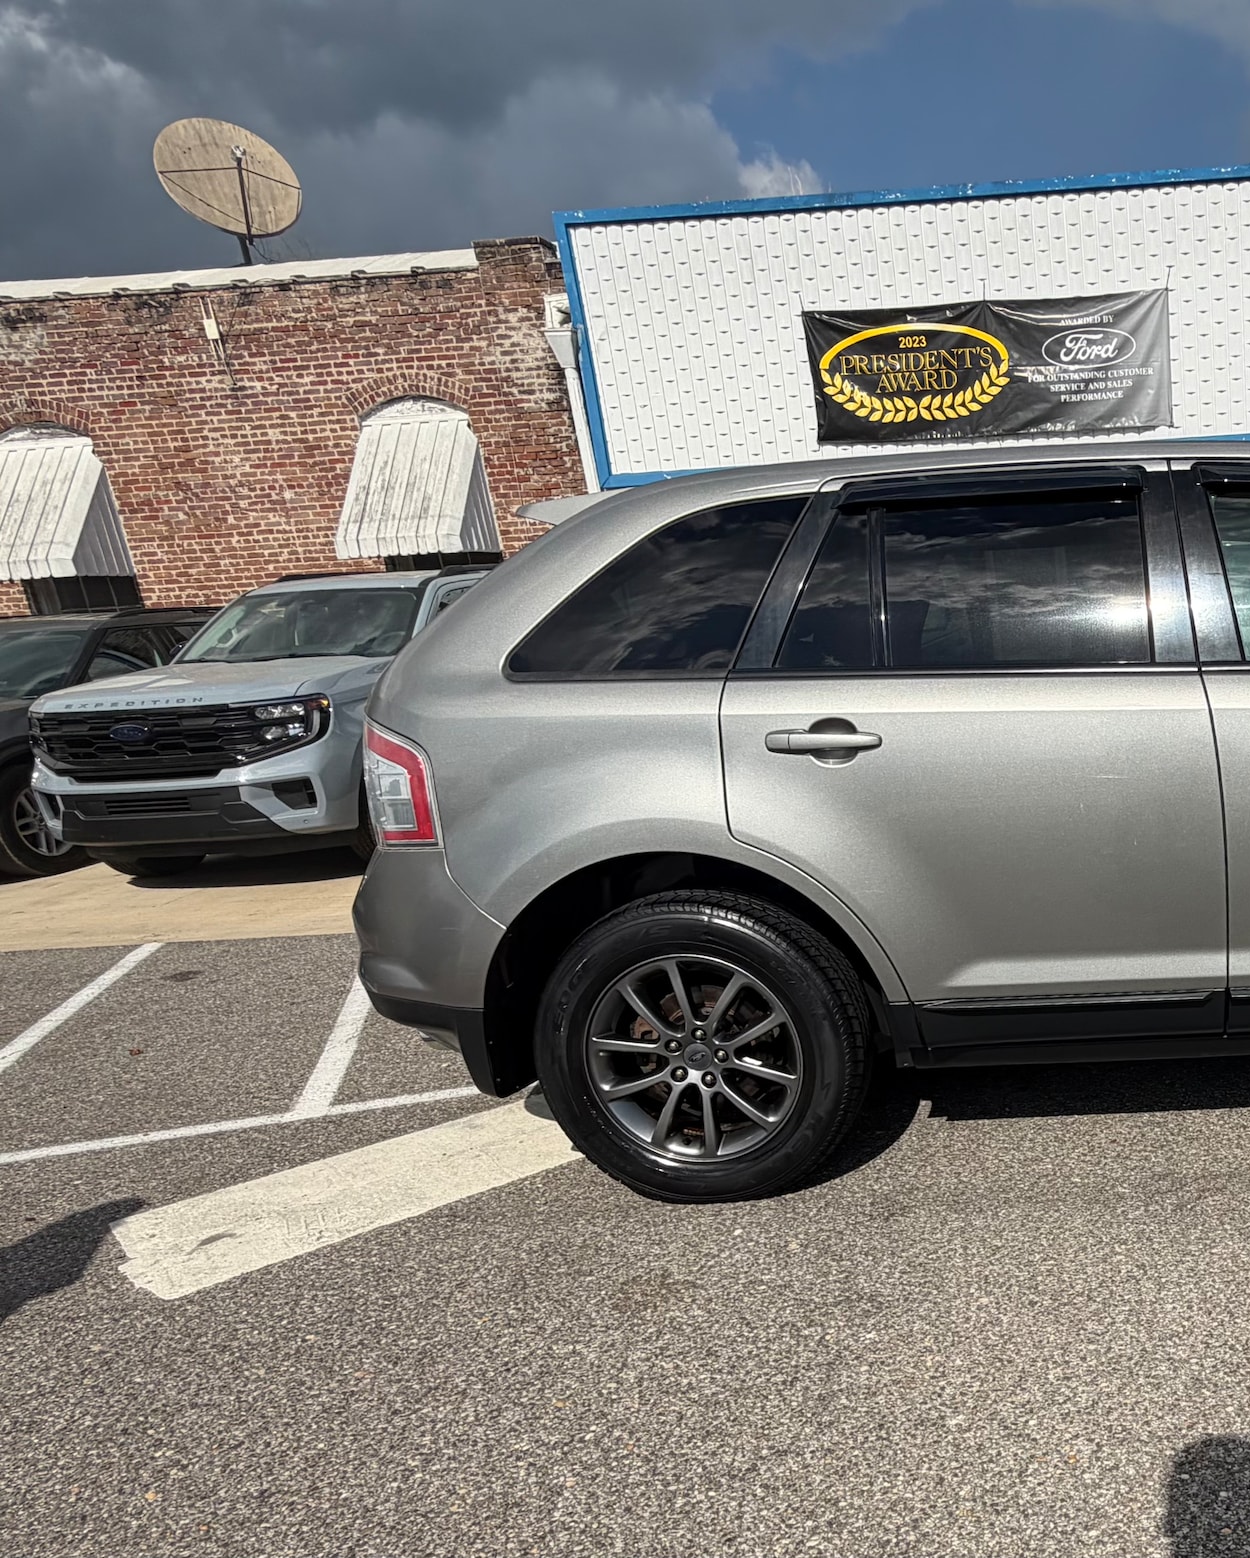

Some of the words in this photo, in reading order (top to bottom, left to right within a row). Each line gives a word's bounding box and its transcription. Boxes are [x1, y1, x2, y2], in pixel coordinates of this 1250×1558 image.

[1060, 315, 1101, 326] AWARDED
[1102, 314, 1115, 324] BY
[898, 335, 928, 349] 2023
[1059, 333, 1119, 362] Ford
[838, 346, 994, 376] PRESIDENT'S
[875, 369, 959, 394] AWARD
[1028, 373, 1045, 383] FOR
[1046, 369, 1106, 382] OUTSTANDING
[1107, 367, 1154, 379] CUSTOMER
[1049, 382, 1086, 393] SERVICE
[1087, 381, 1106, 391] AND
[1107, 379, 1133, 389] SALES
[1060, 390, 1124, 403] PERFORMANCE
[64, 697, 204, 710] EXPEDITION
